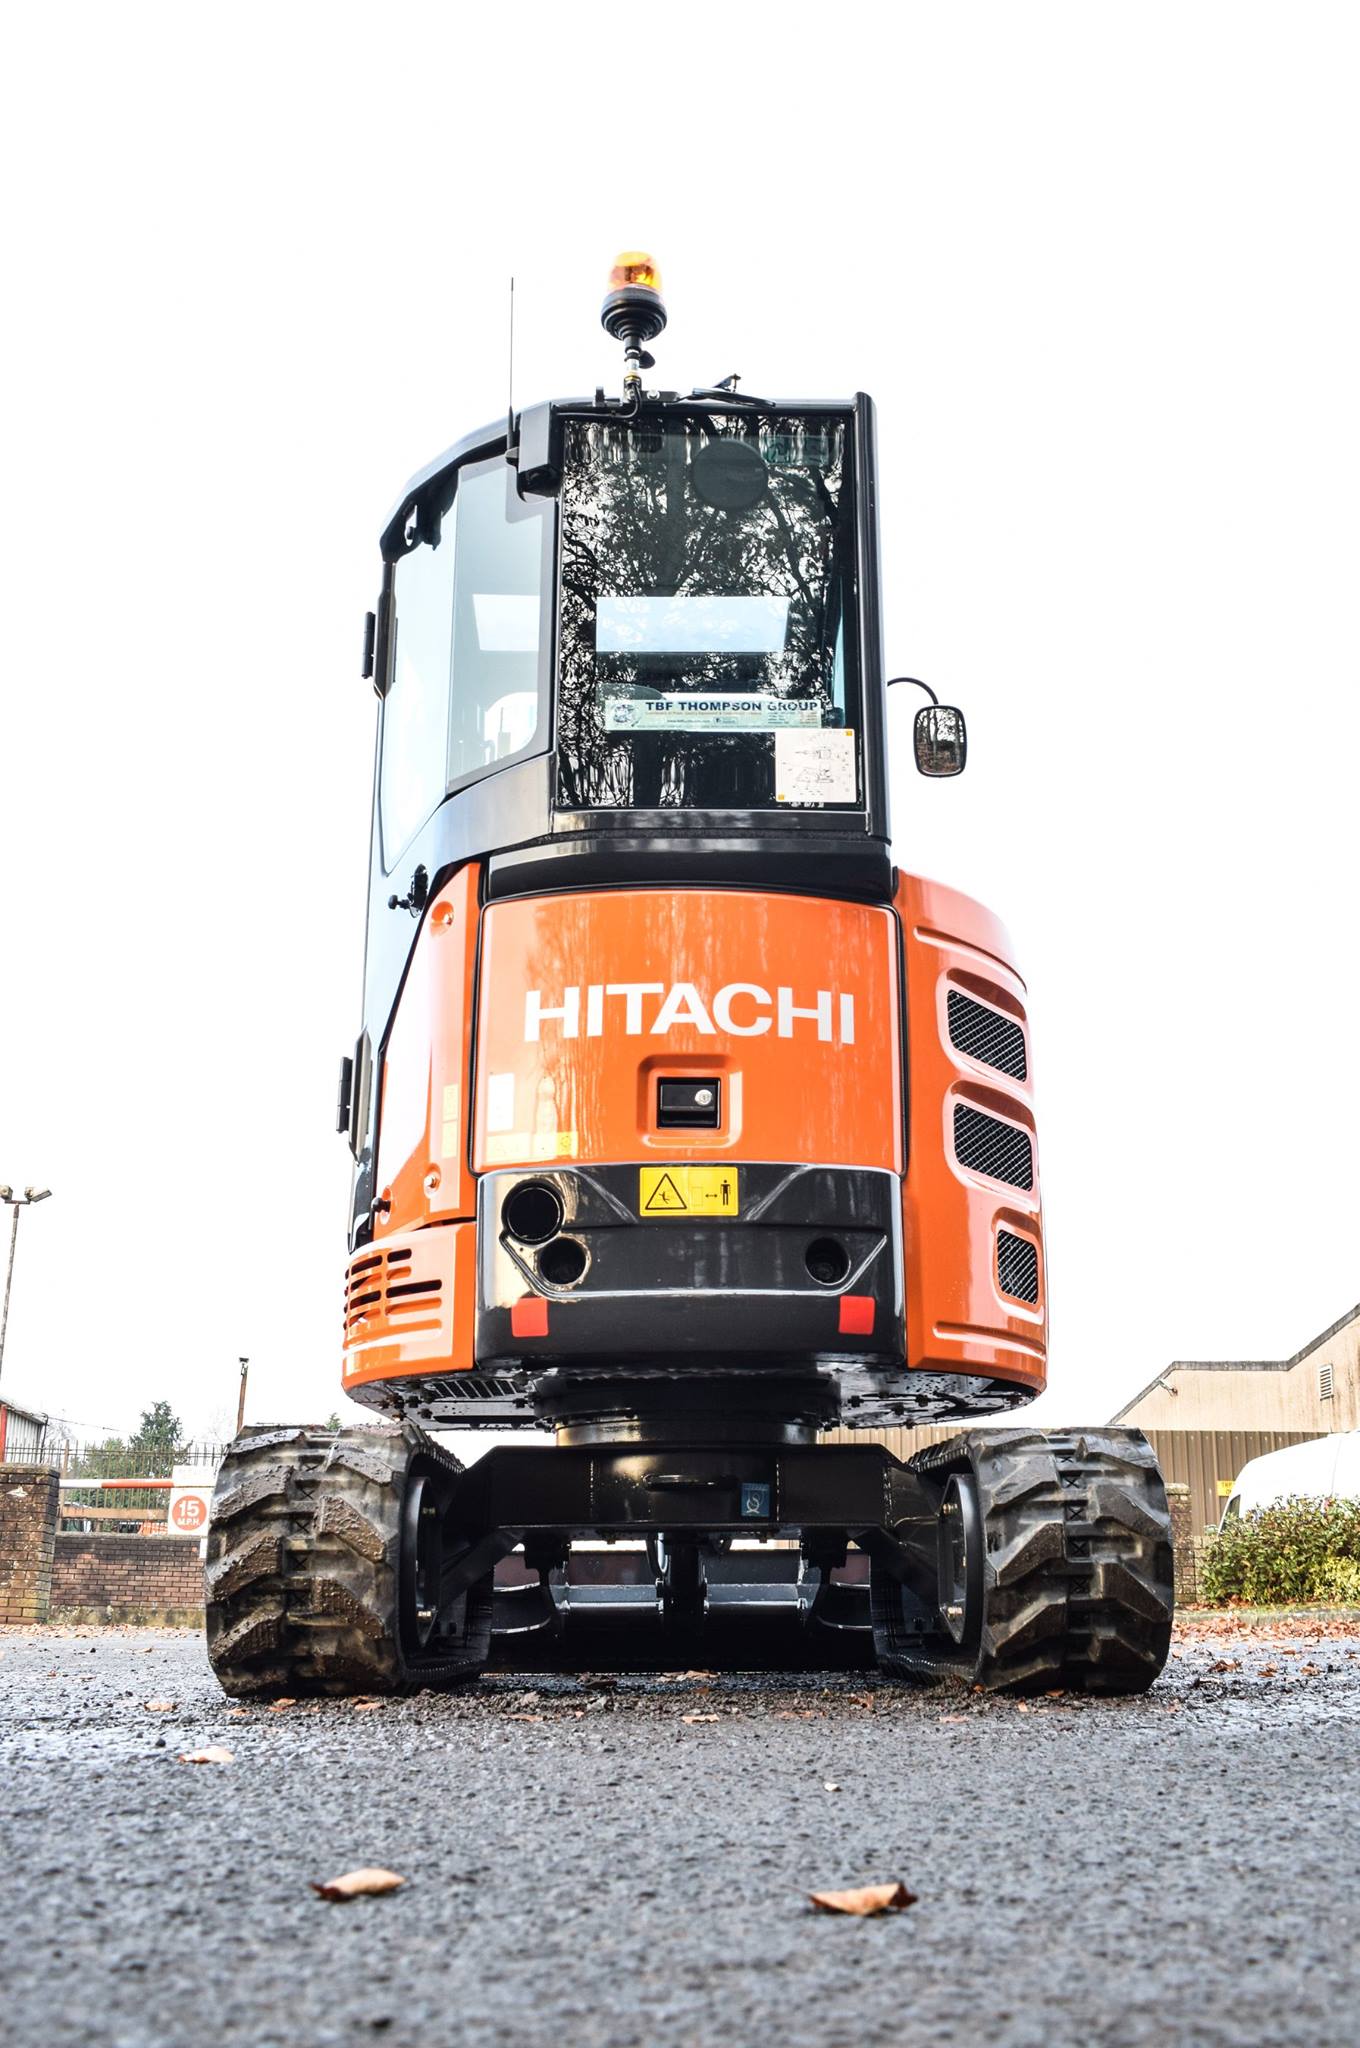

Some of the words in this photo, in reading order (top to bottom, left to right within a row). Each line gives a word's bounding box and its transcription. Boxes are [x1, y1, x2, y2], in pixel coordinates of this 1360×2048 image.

[645, 702, 673, 711] TBF
[678, 702, 762, 711] THOMPSON
[767, 702, 818, 711] GROUP
[524, 983, 855, 1045] HITACHI
[179, 1500, 199, 1517] 15
